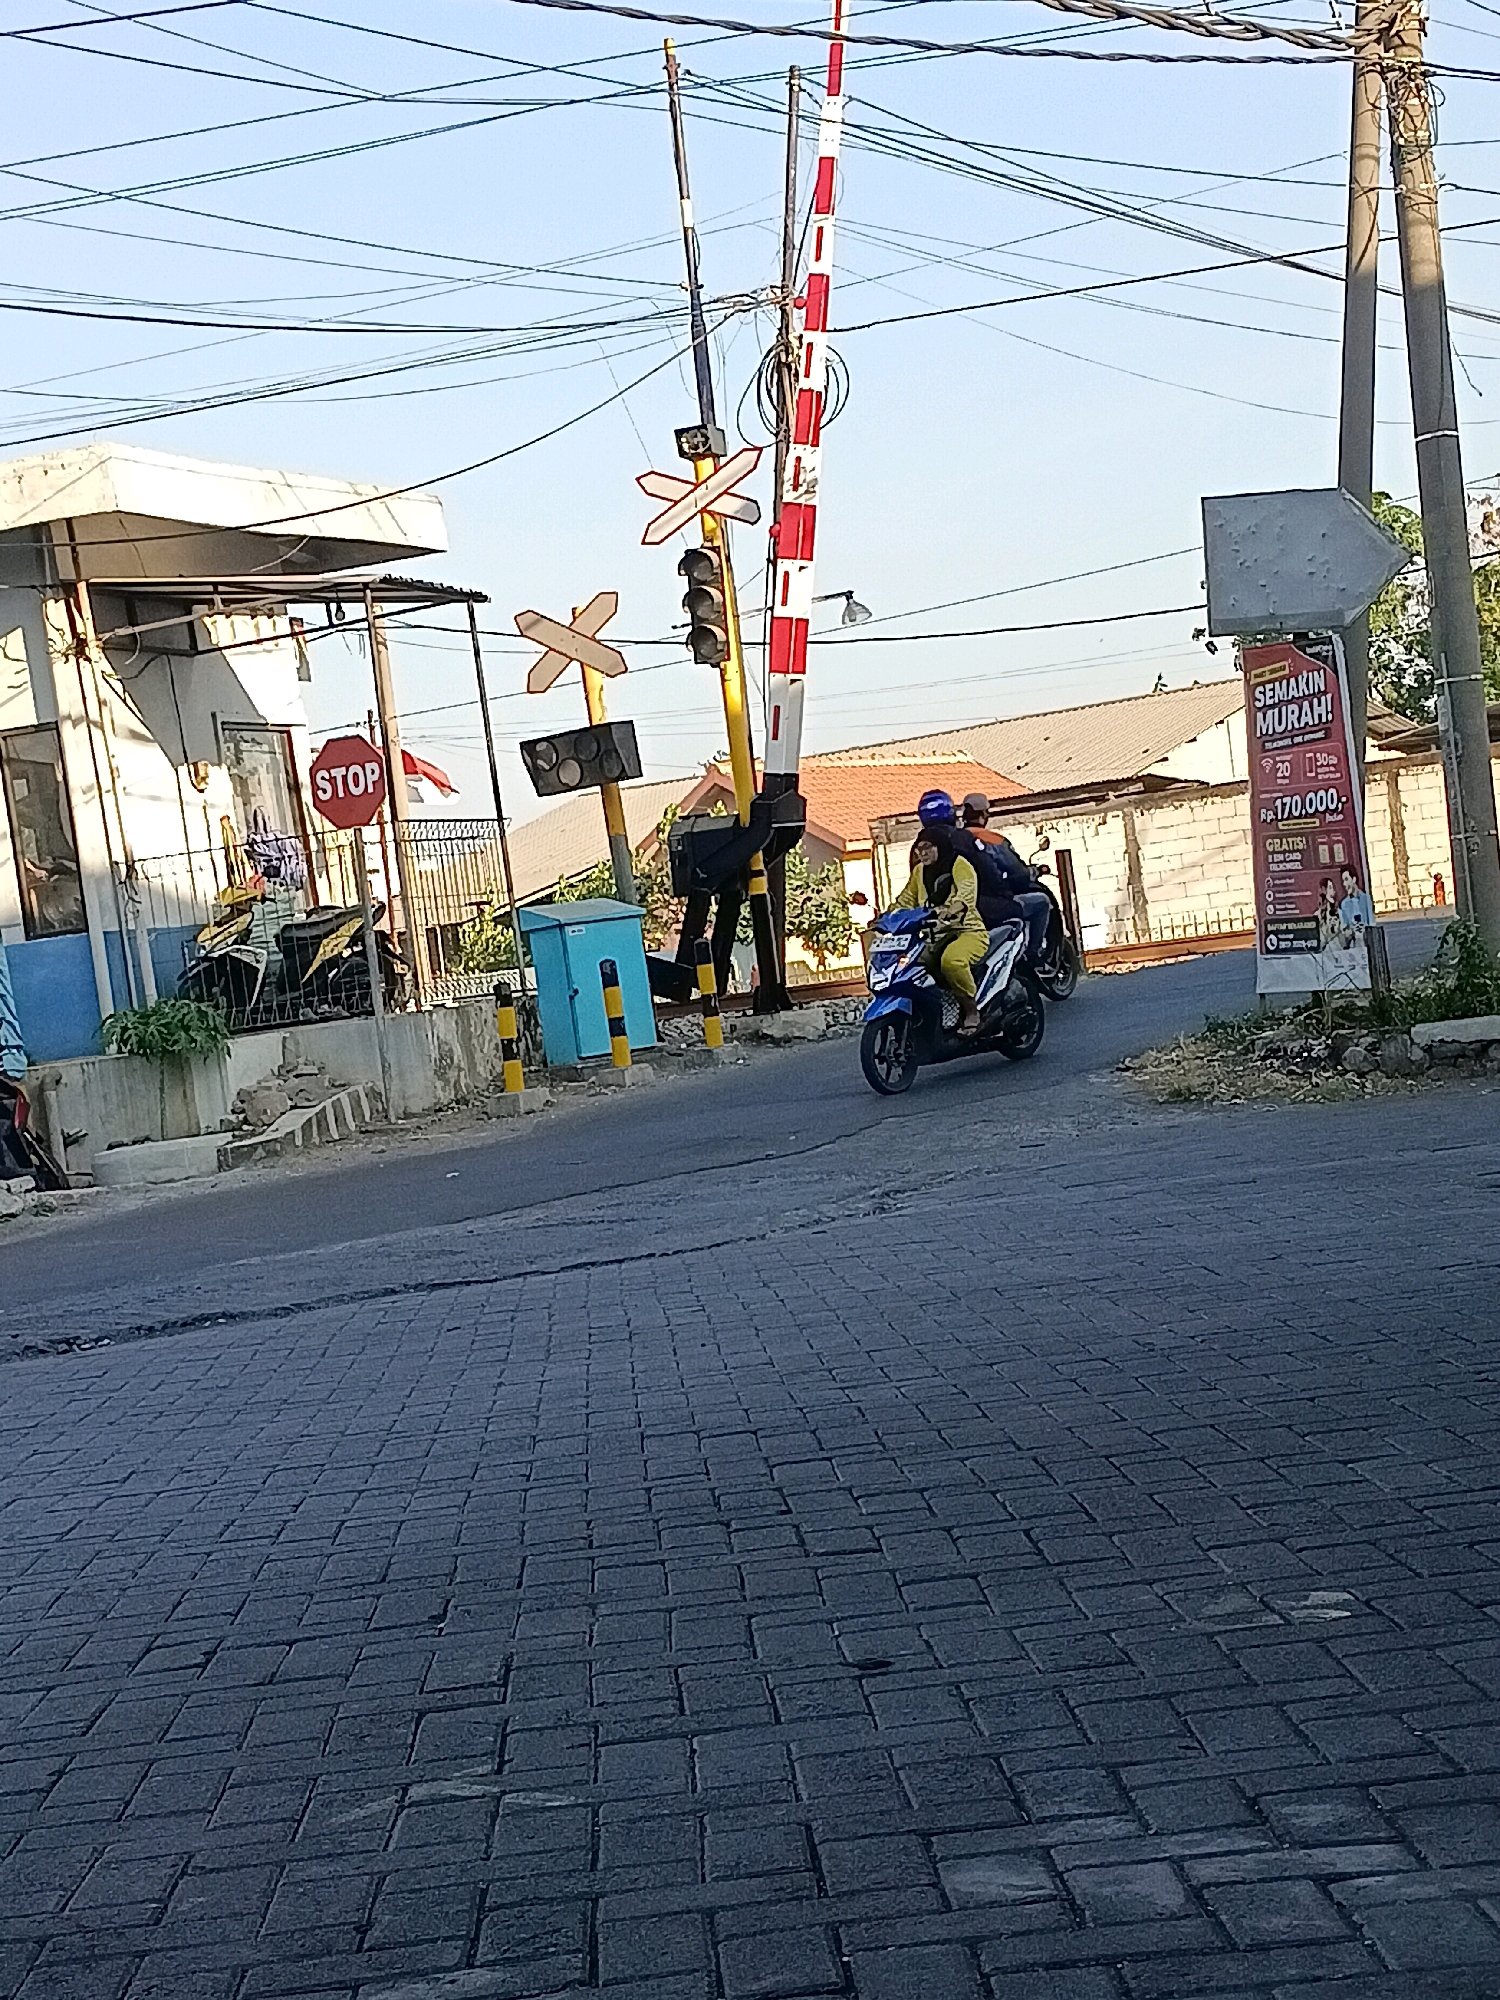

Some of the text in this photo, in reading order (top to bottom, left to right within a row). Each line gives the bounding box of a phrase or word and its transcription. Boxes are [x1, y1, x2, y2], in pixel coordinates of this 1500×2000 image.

[1254, 669, 1325, 708] SEMAKIN
[1256, 693, 1332, 737] MURAH!
[315, 762, 380, 801] STOP
[1276, 762, 1290, 777] 20
[1265, 836, 1307, 851] GRATIS!
